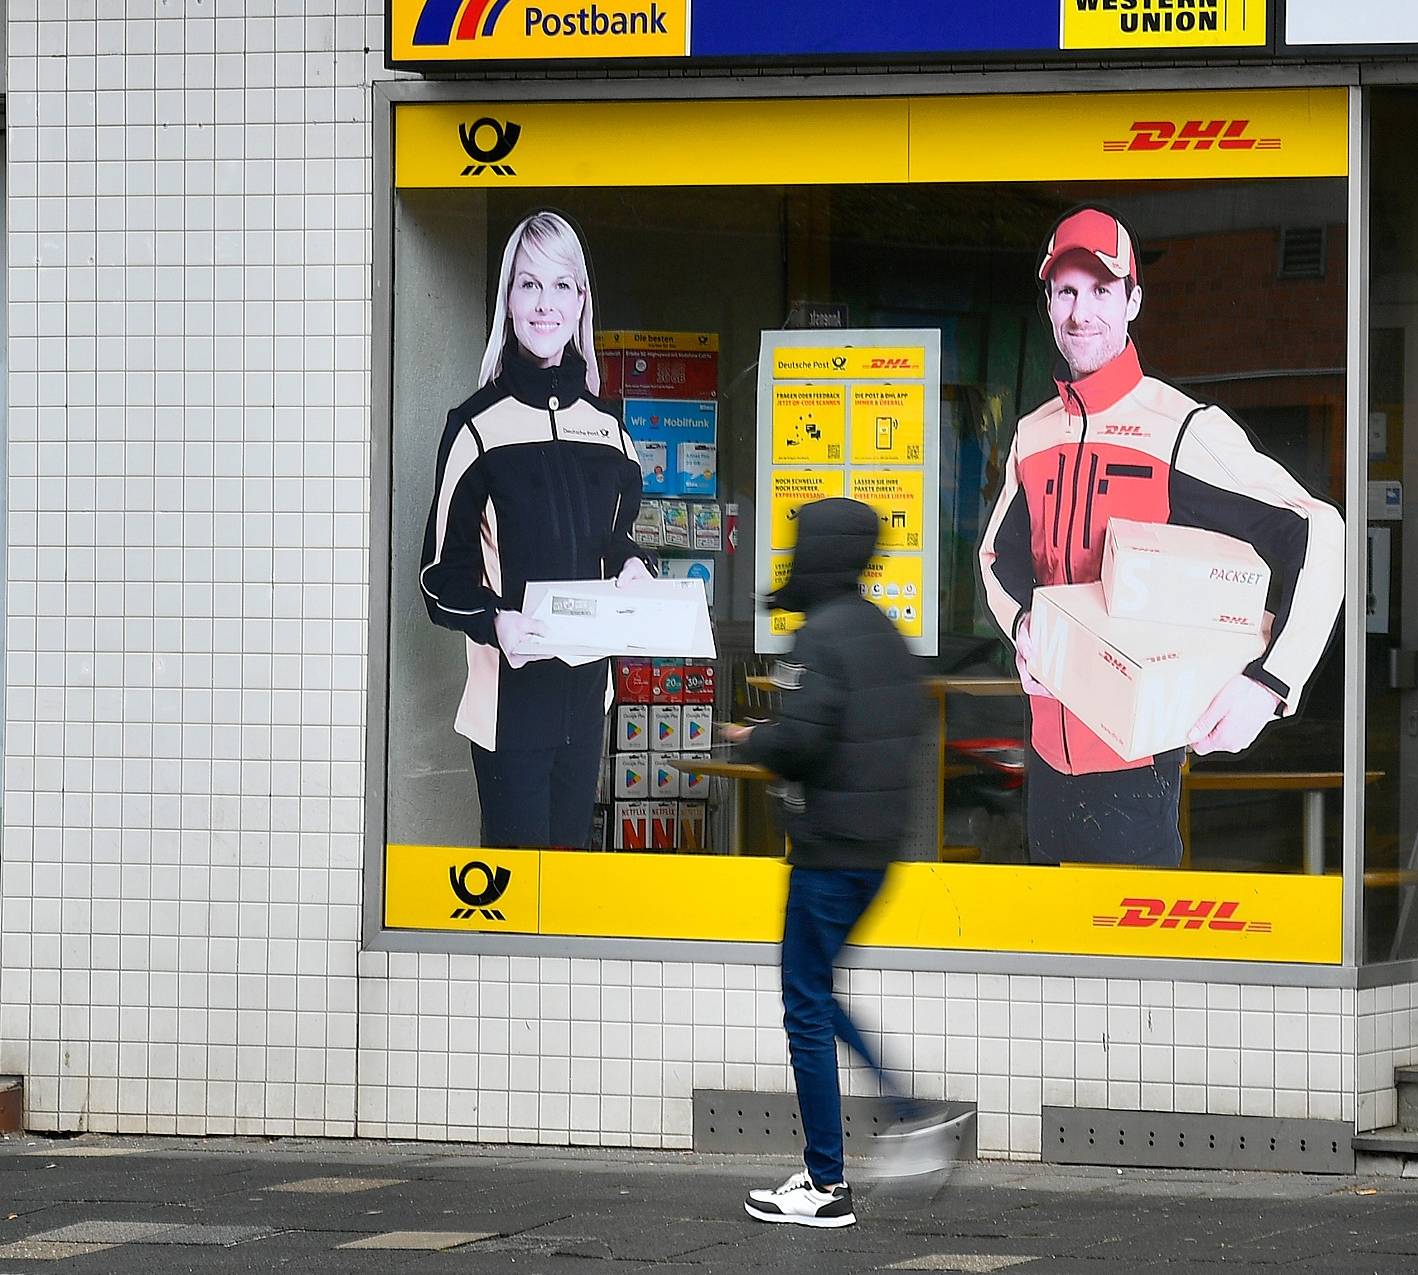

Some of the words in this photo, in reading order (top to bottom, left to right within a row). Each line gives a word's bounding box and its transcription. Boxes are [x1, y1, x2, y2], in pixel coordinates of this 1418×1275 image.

[525, 3, 668, 36] Postbank
[1120, 11, 1217, 32] UNION
[1127, 120, 1257, 151] DHL
[778, 361, 812, 369] Deutsche
[813, 361, 829, 369] Post
[870, 358, 911, 369] DHL
[631, 416, 646, 426] Wir
[663, 417, 710, 428] Mobilfunk
[1104, 424, 1143, 437] DHL
[1209, 567, 1264, 586] PACKSET
[1218, 614, 1250, 627] DHL
[1103, 650, 1129, 677] DHL
[621, 808, 647, 817] NETFLIX
[1116, 898, 1248, 932] DHL
